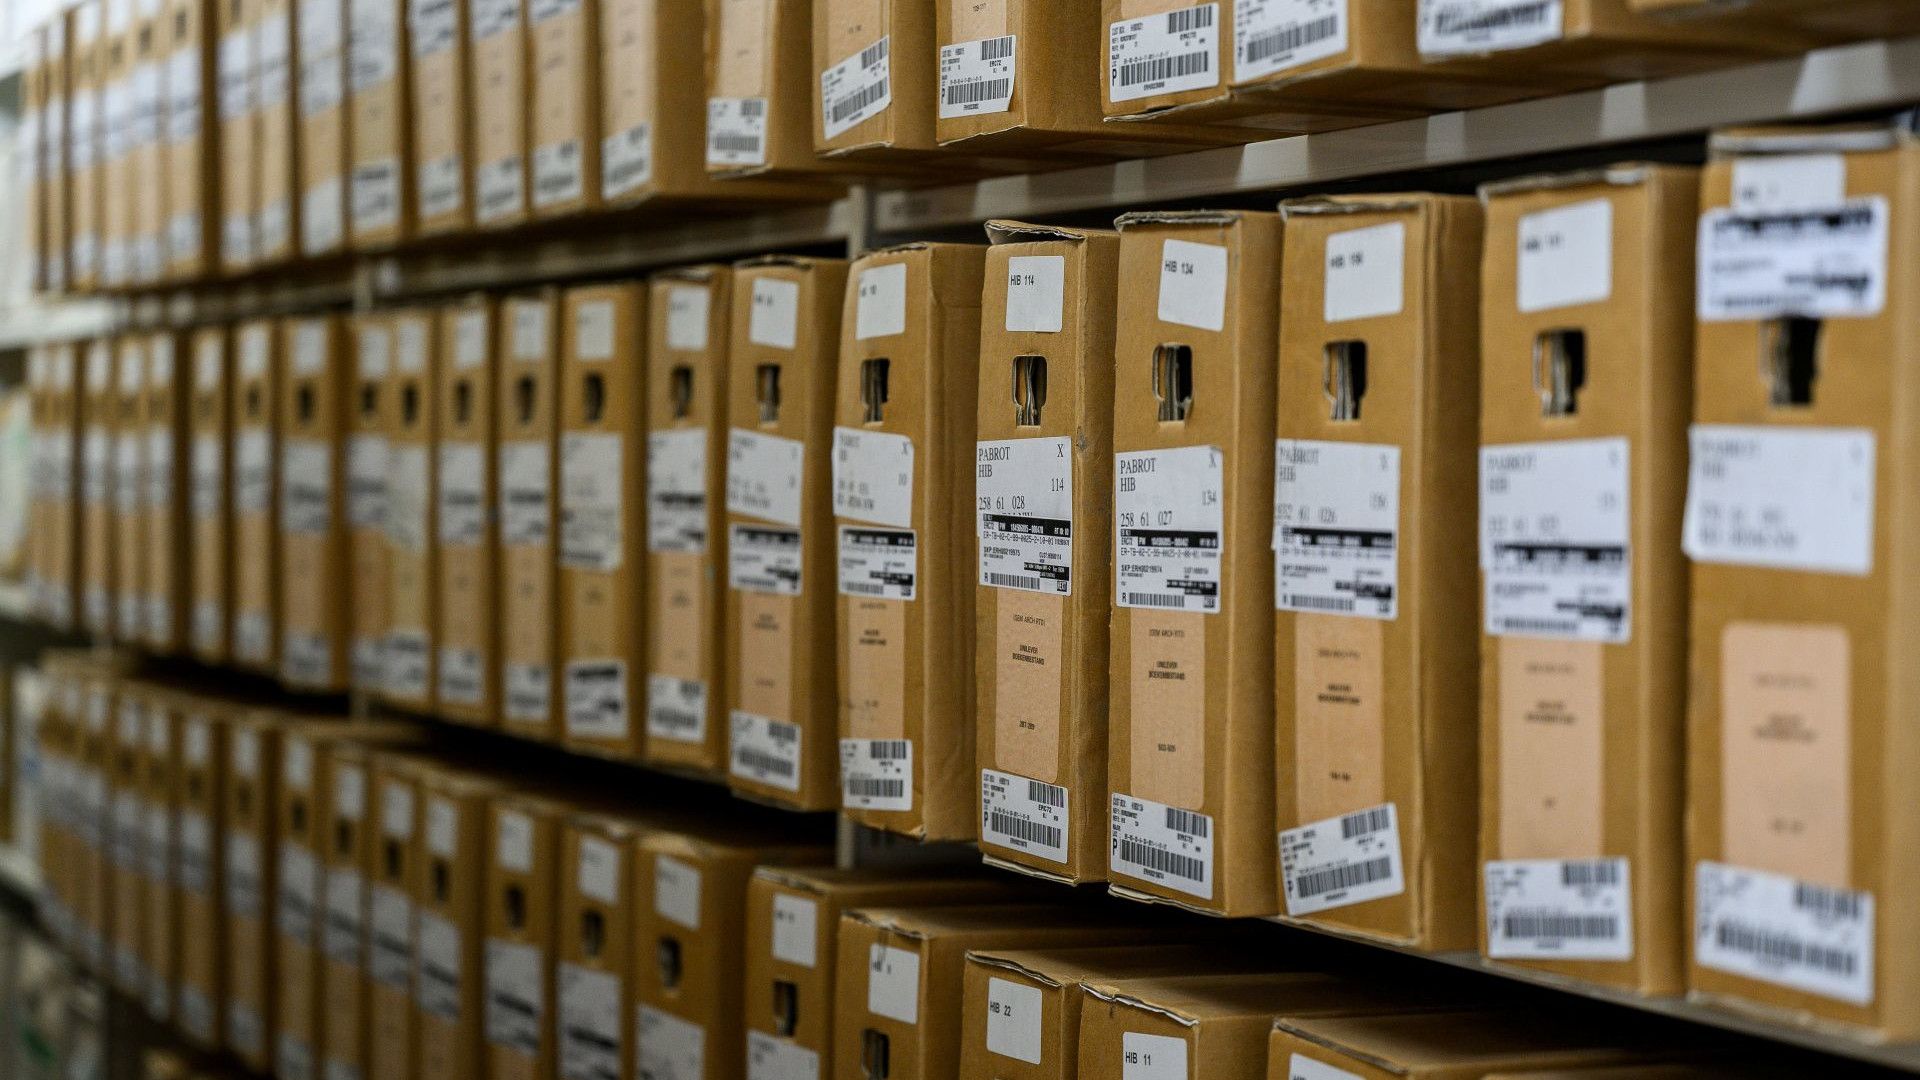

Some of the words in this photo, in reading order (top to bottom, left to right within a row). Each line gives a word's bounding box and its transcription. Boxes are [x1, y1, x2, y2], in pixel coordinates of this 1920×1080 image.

[1112, 68, 1117, 86] P
[1165, 260, 1177, 272] HIB
[1182, 262, 1193, 274] 134
[1010, 275, 1021, 286] HIB
[1025, 275, 1034, 286] 114
[979, 447, 1010, 461] PABROT
[1057, 444, 1064, 458] X
[1120, 458, 1156, 474] PABROT
[1209, 453, 1216, 468] X
[978, 464, 993, 478] HIB
[1051, 478, 1064, 492] 114
[1120, 477, 1136, 492] HIB
[979, 497, 991, 510] 258
[996, 497, 1004, 510] 61
[1012, 496, 1025, 510] 028
[1121, 513, 1134, 527] 258
[1140, 512, 1149, 526] 61
[1158, 511, 1172, 526] 027
[1122, 592, 1126, 603] R
[1113, 838, 1118, 855] P
[990, 1001, 1000, 1013] HIB
[1004, 1004, 1011, 1016] 22
[1125, 1052, 1138, 1064] HIB
[1144, 1054, 1151, 1066] 11
